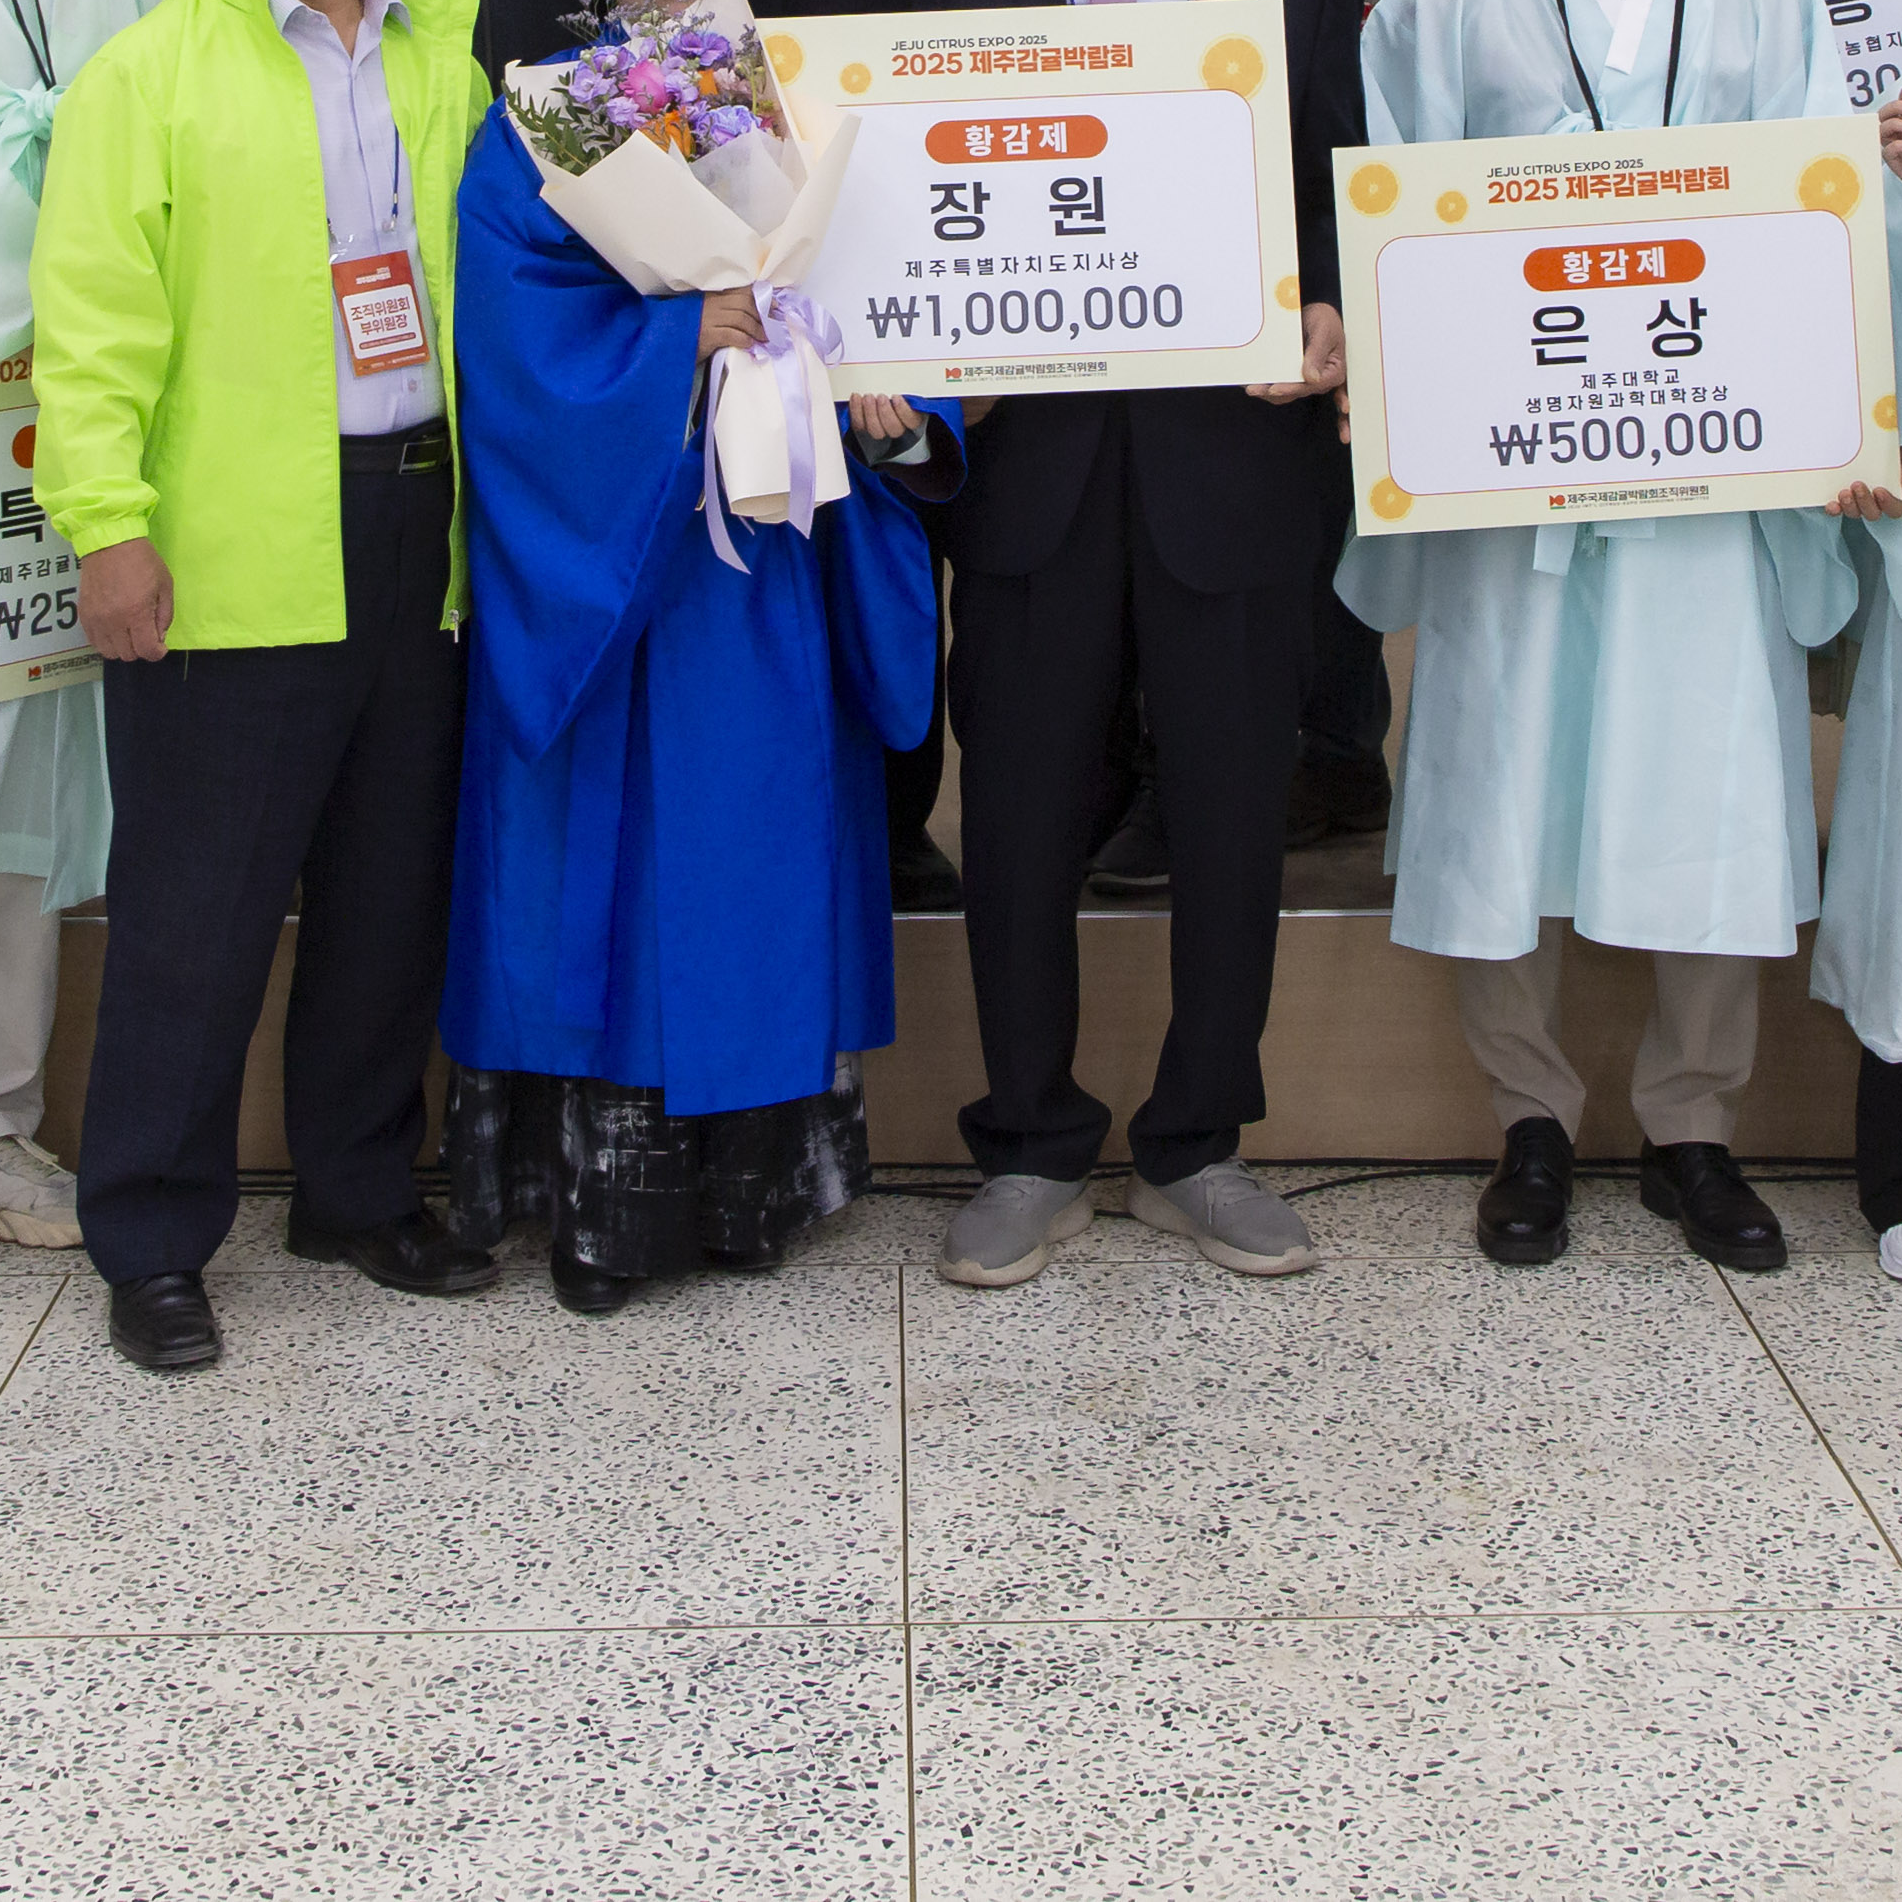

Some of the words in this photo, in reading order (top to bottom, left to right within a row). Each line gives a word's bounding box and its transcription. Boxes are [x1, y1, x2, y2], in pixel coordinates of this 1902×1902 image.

[891, 40, 925, 51] JEJU
[928, 38, 975, 50] CITRUS
[978, 36, 1015, 47] EXPO
[1018, 34, 1048, 46] 2025
[891, 52, 963, 77] 2025
[969, 44, 1134, 74] 제주감귤박람회
[964, 122, 1068, 157] 황감제
[1487, 166, 1520, 178] JEJU
[1523, 163, 1571, 176] CITRUS
[1574, 160, 1611, 173] EXPO
[1615, 158, 1644, 170] 2025
[1487, 177, 1559, 204] 2025
[1565, 165, 1730, 200] 제주감귤박람회
[905, 251, 1139, 279] 제주특별자치도지사상
[1562, 246, 1666, 284] 황감제
[350, 296, 411, 321] 조직위원회
[360, 314, 409, 336] 부위원장
[1581, 368, 1680, 390] 제주대학교
[1525, 384, 1729, 414] 생명자원과학대학장상
